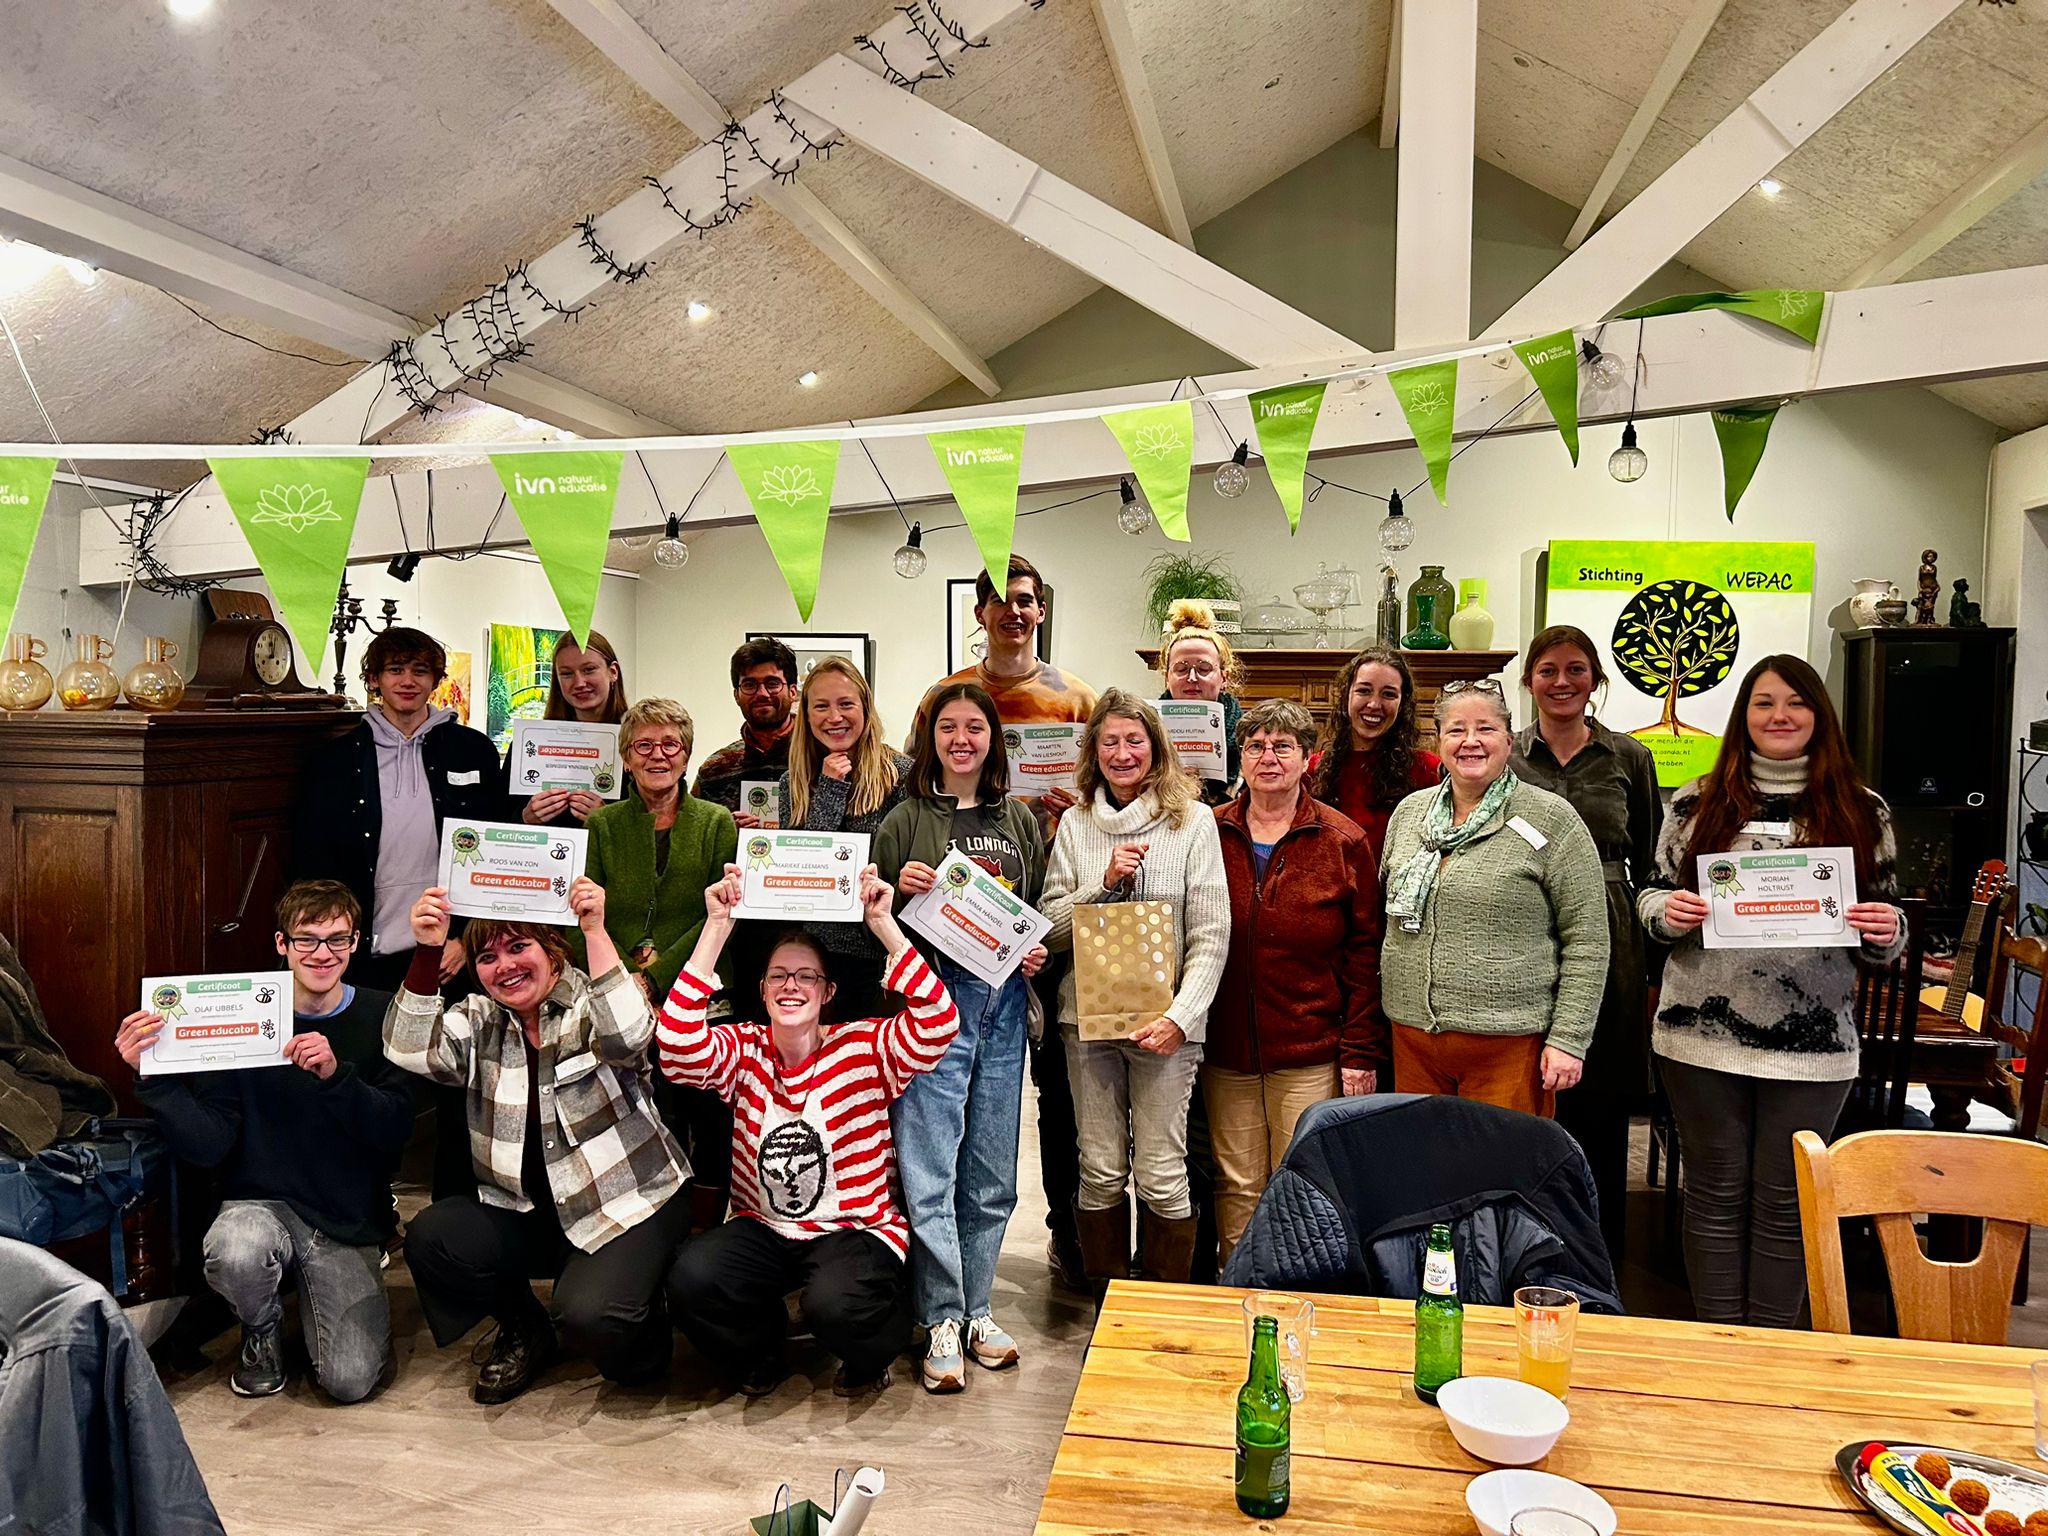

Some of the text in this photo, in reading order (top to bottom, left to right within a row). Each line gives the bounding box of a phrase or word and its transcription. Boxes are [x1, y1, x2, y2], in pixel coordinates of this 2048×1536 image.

[1526, 352, 1549, 366] ivn
[1260, 400, 1284, 417] ivn
[946, 447, 977, 467] ivn
[514, 472, 555, 495] ivn
[558, 475, 593, 484] natuur
[558, 483, 607, 493] educatie
[1578, 568, 1793, 590] Stichting WEPAC
[540, 747, 598, 757] Green educator
[1179, 743, 1211, 751] educator
[1021, 764, 1073, 773] Green educato
[496, 831, 538, 842] Certificaat
[786, 838, 824, 847] Certificaat
[489, 858, 539, 868] ROOS VAN ZON
[1752, 857, 1796, 867] Certificaat
[472, 874, 547, 889] Green educator
[766, 878, 833, 888] Green educator
[1757, 884, 1795, 892] HOLTRUST
[1737, 902, 1816, 913] Green educator
[943, 906, 964, 927] Green
[963, 921, 997, 948] educator
[197, 983, 241, 992] Certificaat
[194, 1004, 244, 1013] OLAF UBBELS
[178, 1025, 255, 1037] Green educator
